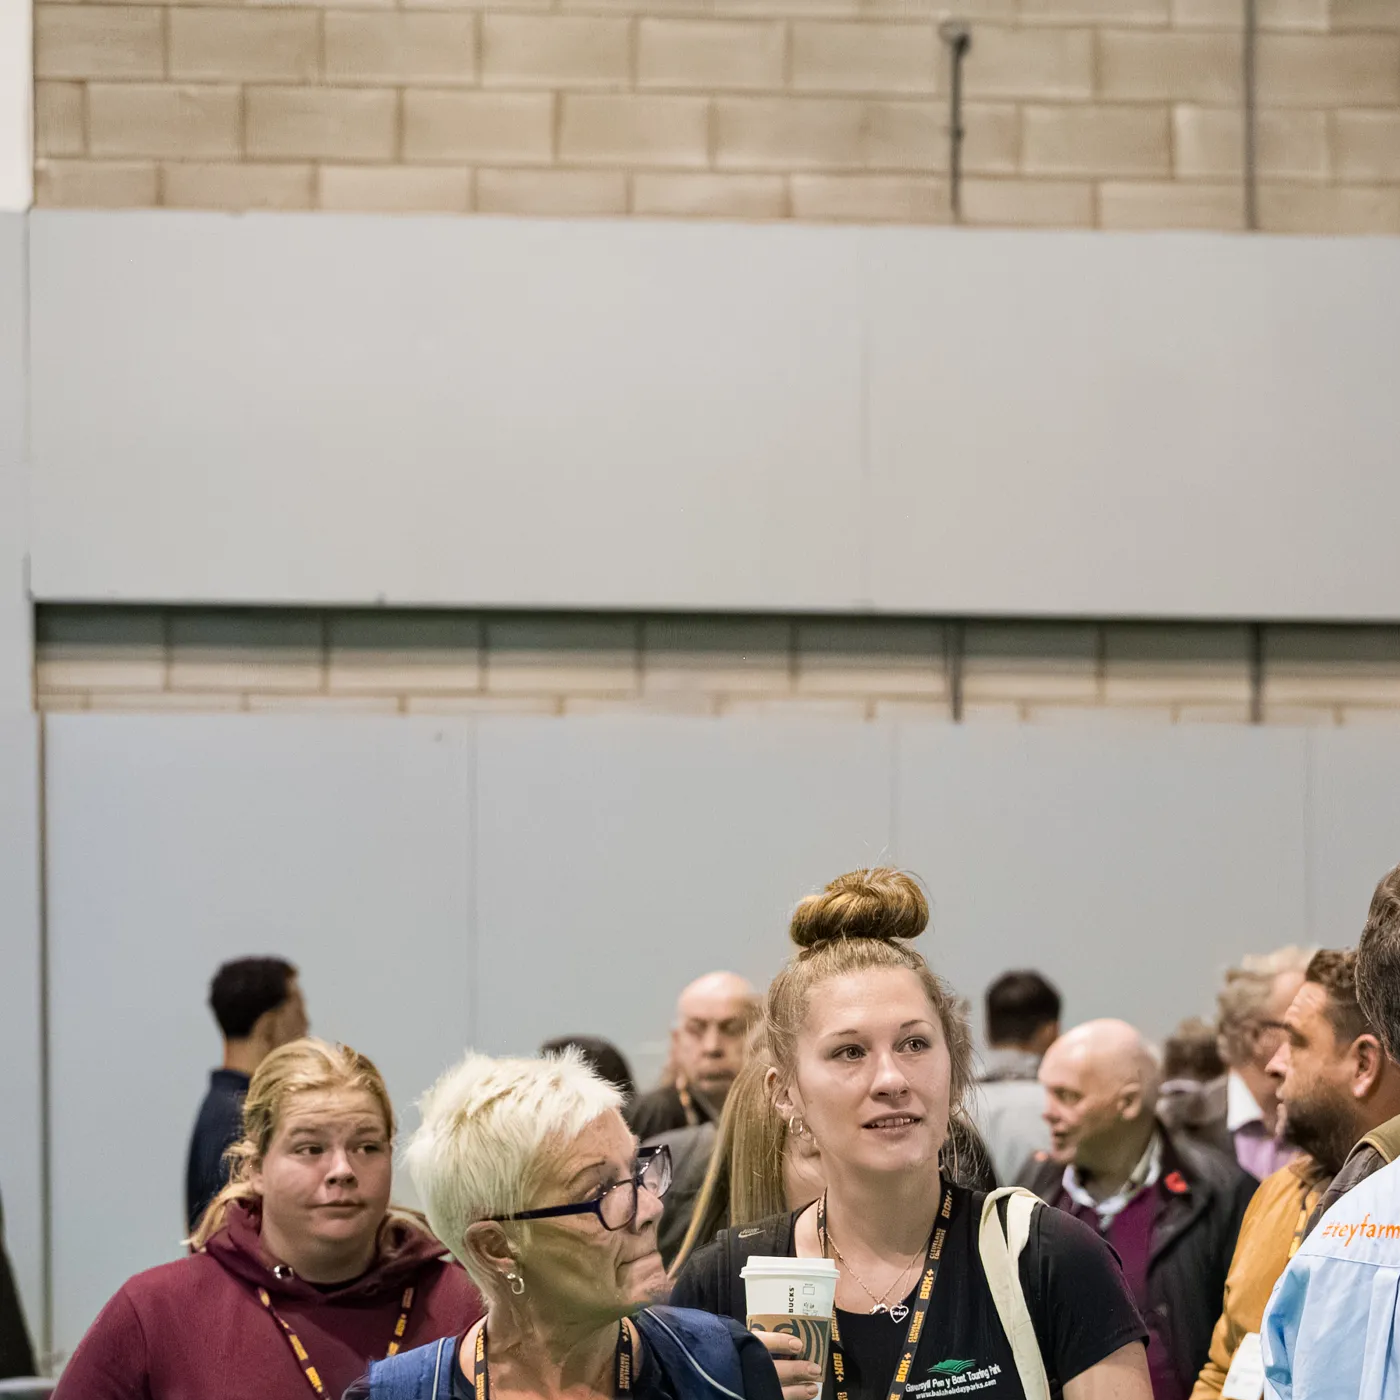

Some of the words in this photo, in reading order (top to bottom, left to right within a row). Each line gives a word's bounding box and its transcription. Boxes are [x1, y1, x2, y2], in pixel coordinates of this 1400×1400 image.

[920, 1268, 935, 1300] BOX+
[832, 1352, 844, 1383] BOX+
[895, 1352, 912, 1383] BOX+
